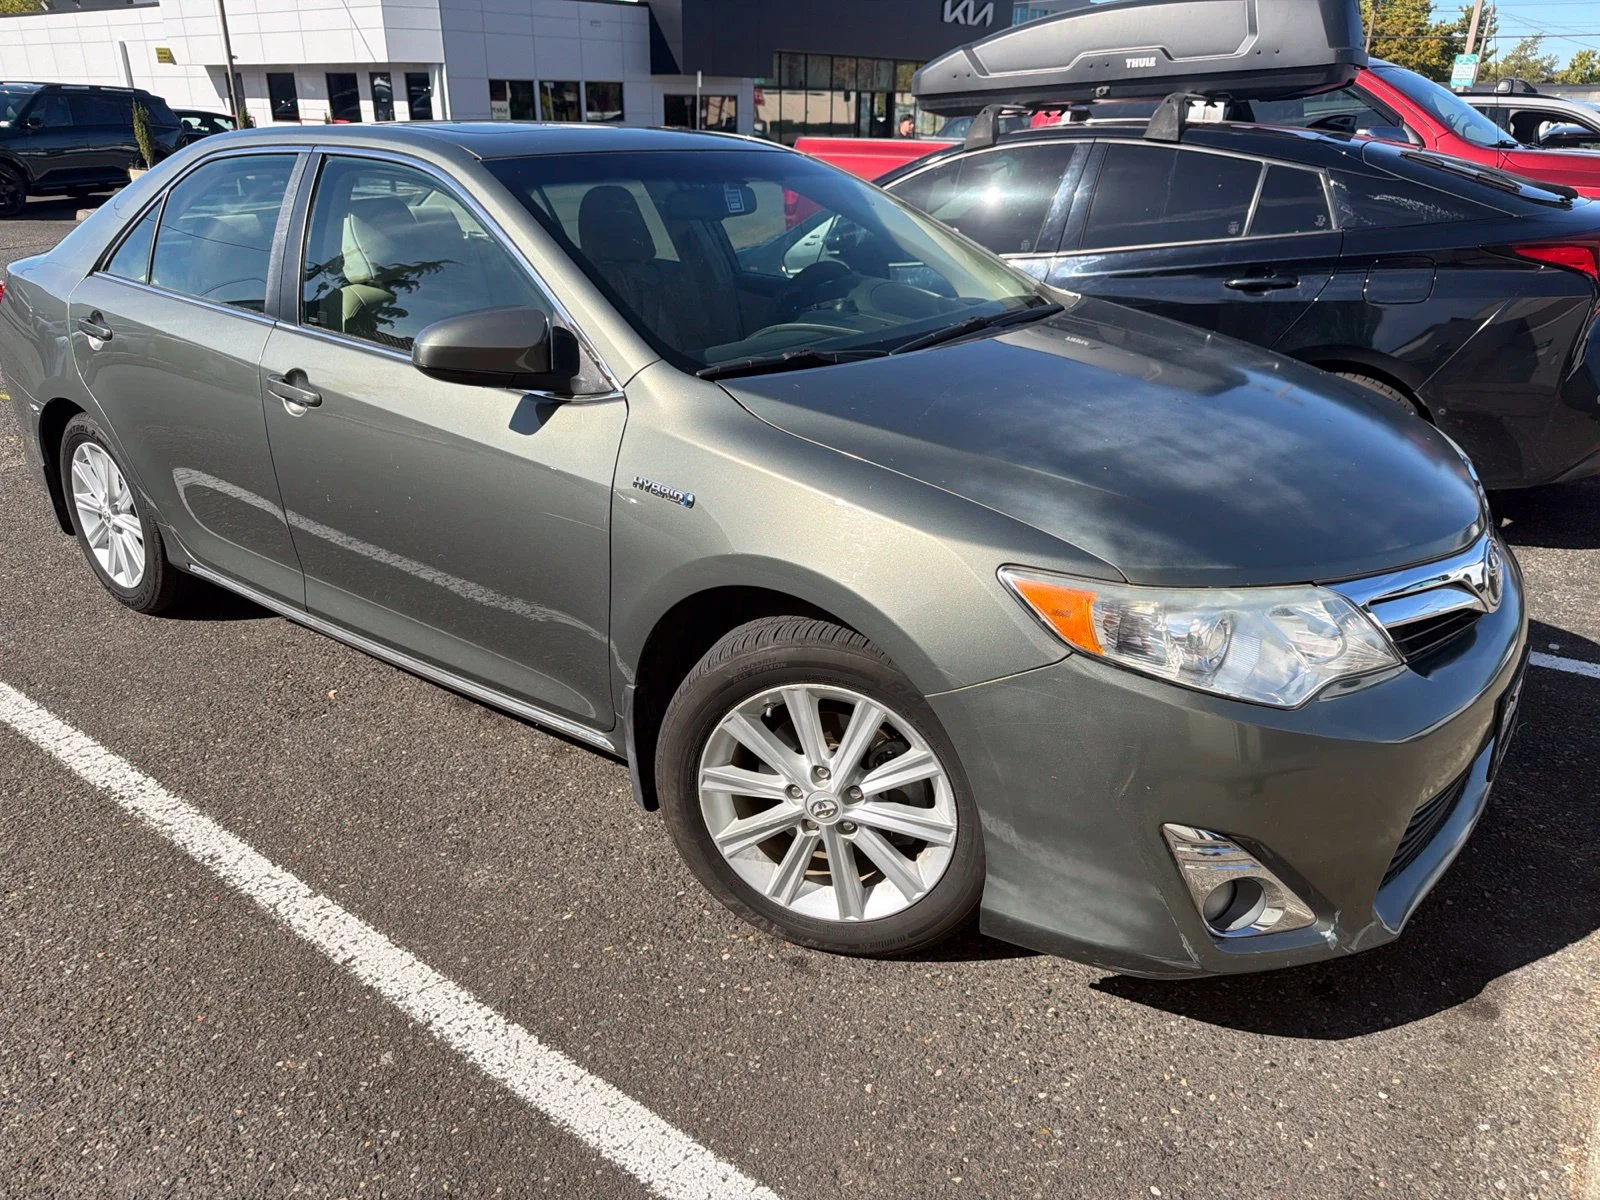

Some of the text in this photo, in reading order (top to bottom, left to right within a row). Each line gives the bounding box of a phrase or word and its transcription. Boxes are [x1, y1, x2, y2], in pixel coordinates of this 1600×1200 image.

[943, 0, 994, 28] KIA
[1125, 56, 1157, 69] THULE
[632, 476, 685, 505] HYBRID
